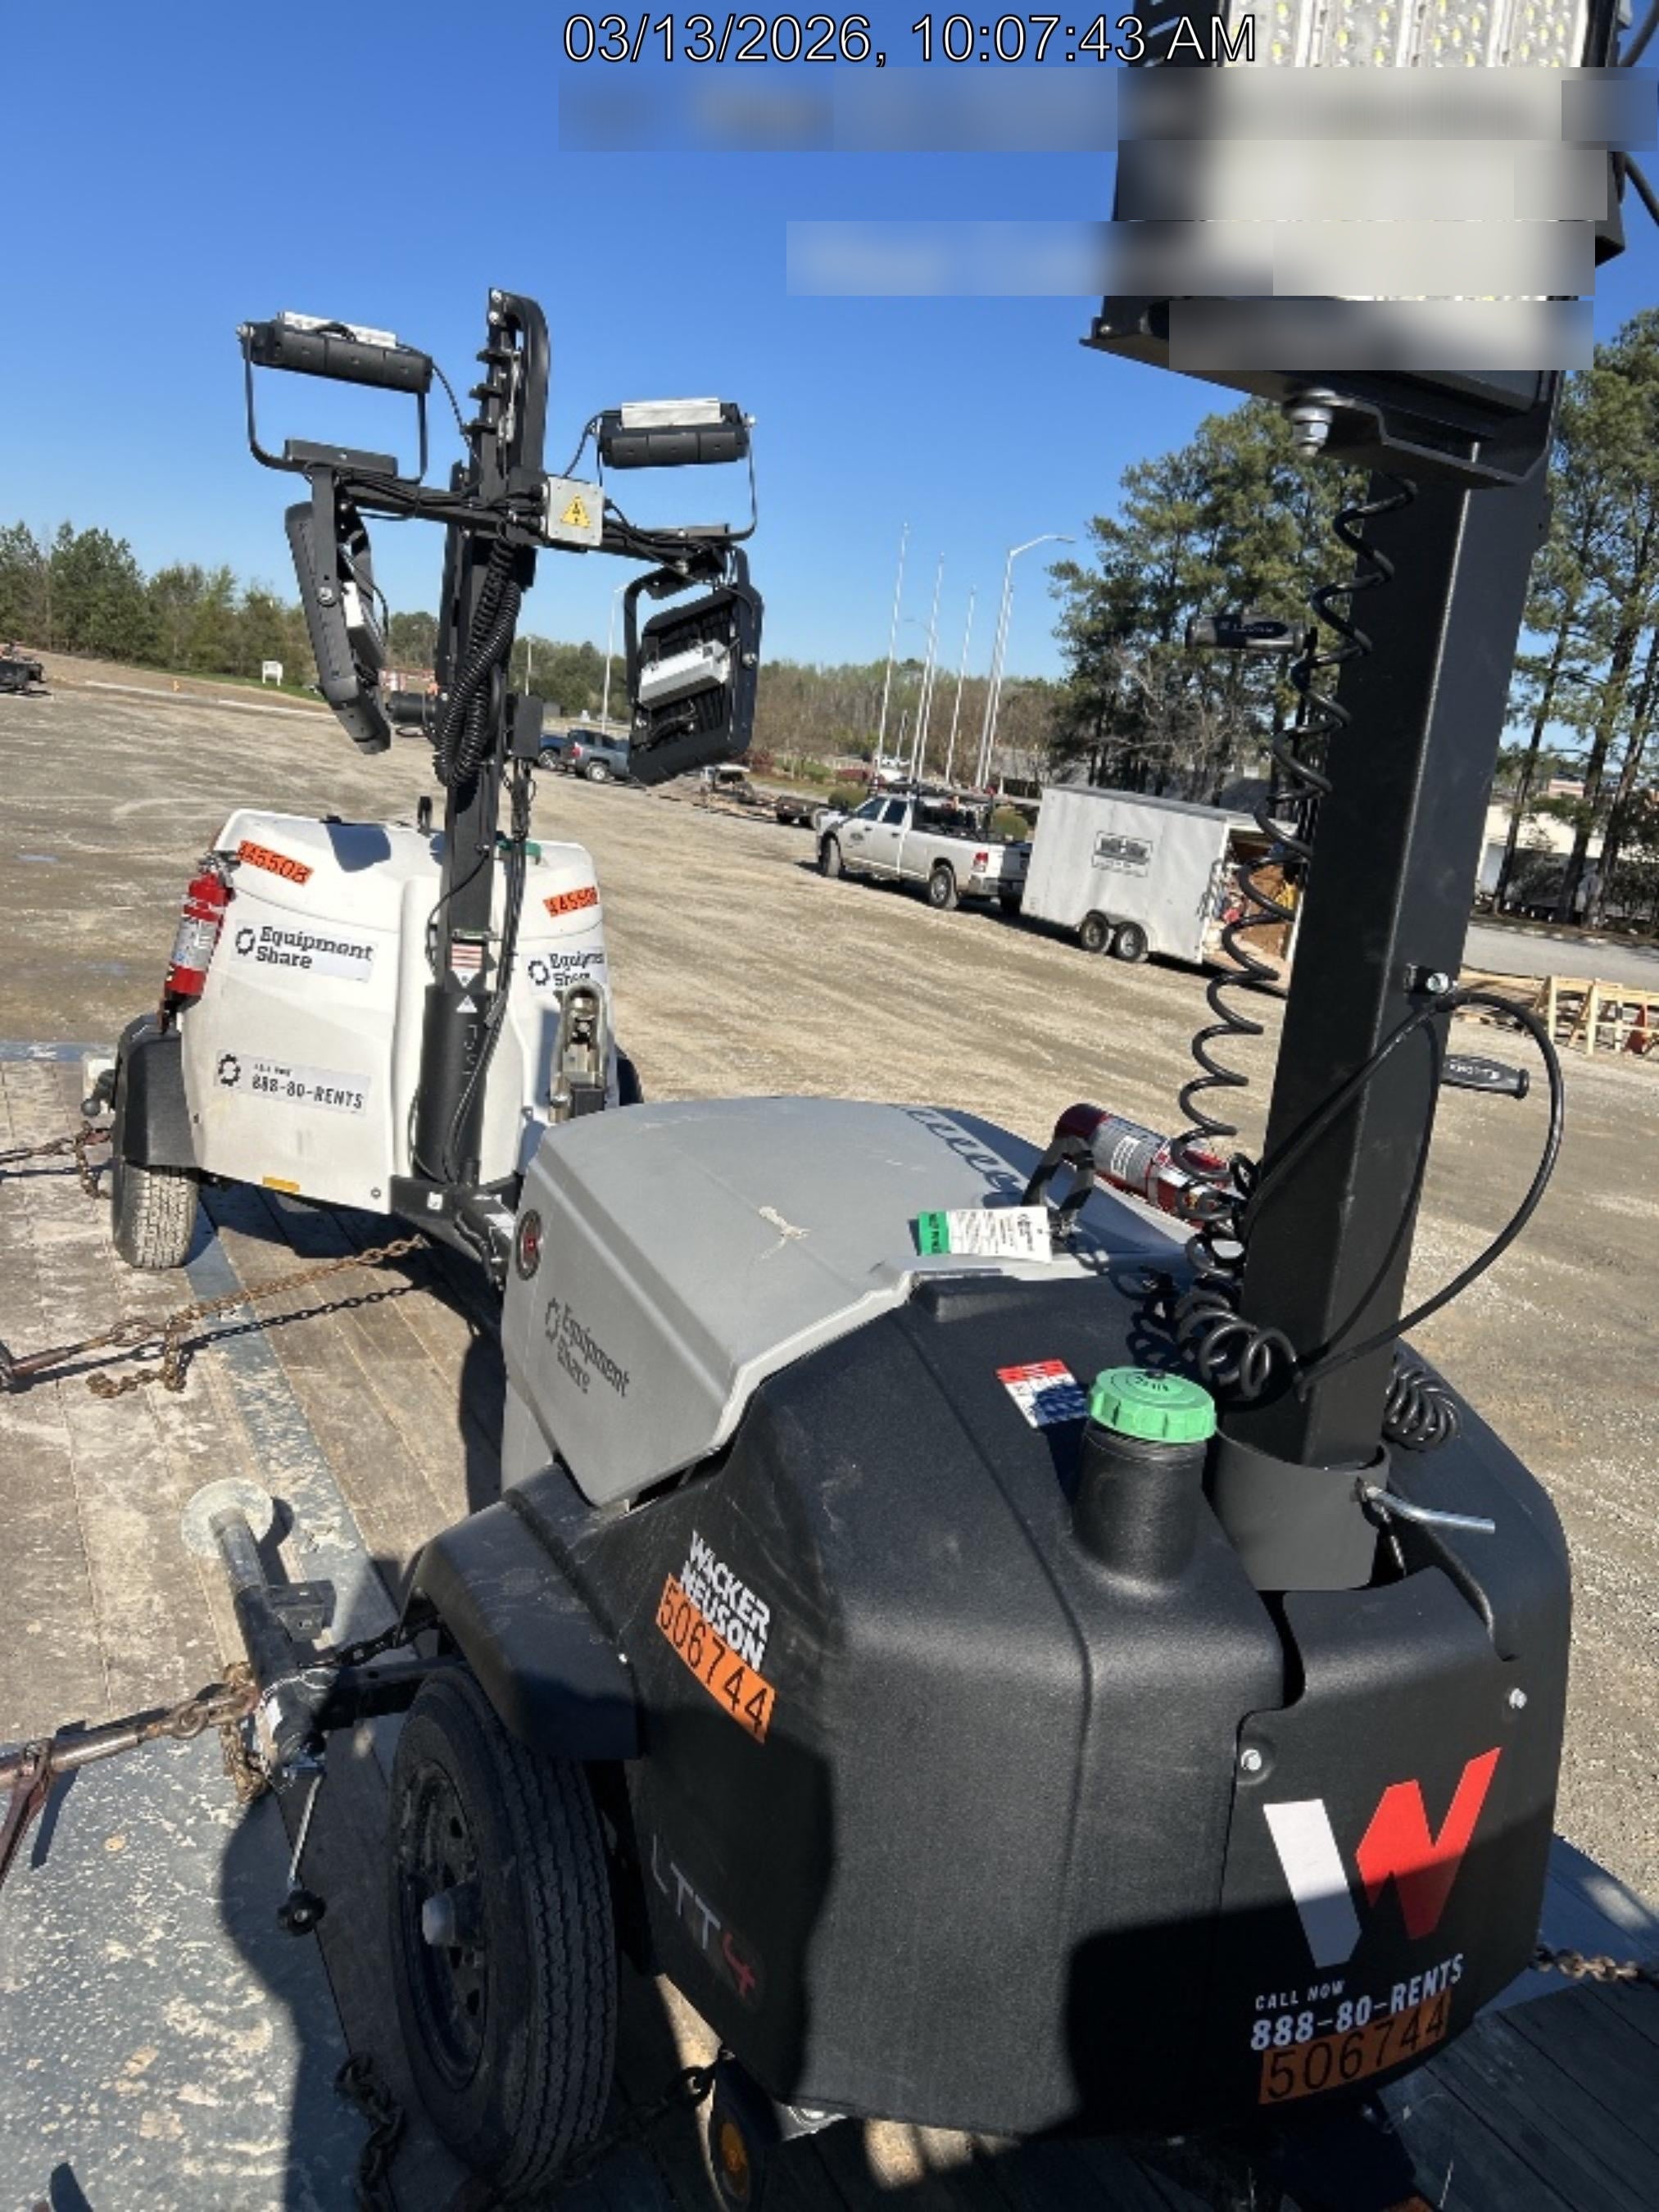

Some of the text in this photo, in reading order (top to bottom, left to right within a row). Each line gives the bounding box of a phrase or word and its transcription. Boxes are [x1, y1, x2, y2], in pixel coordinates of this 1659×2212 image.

[256, 946, 312, 968] Share
[260, 927, 373, 962] Equipment
[252, 1076, 364, 1108] 888-80-RENTS
[562, 1303, 629, 1398] Equipment
[690, 1529, 771, 1642] WACKER
[660, 1582, 768, 1734] 506744
[1250, 1952, 1464, 2051] 888-80-RENTS
[1255, 1979, 1346, 2010] CALL NOW
[1267, 1992, 1448, 2100] 506744
